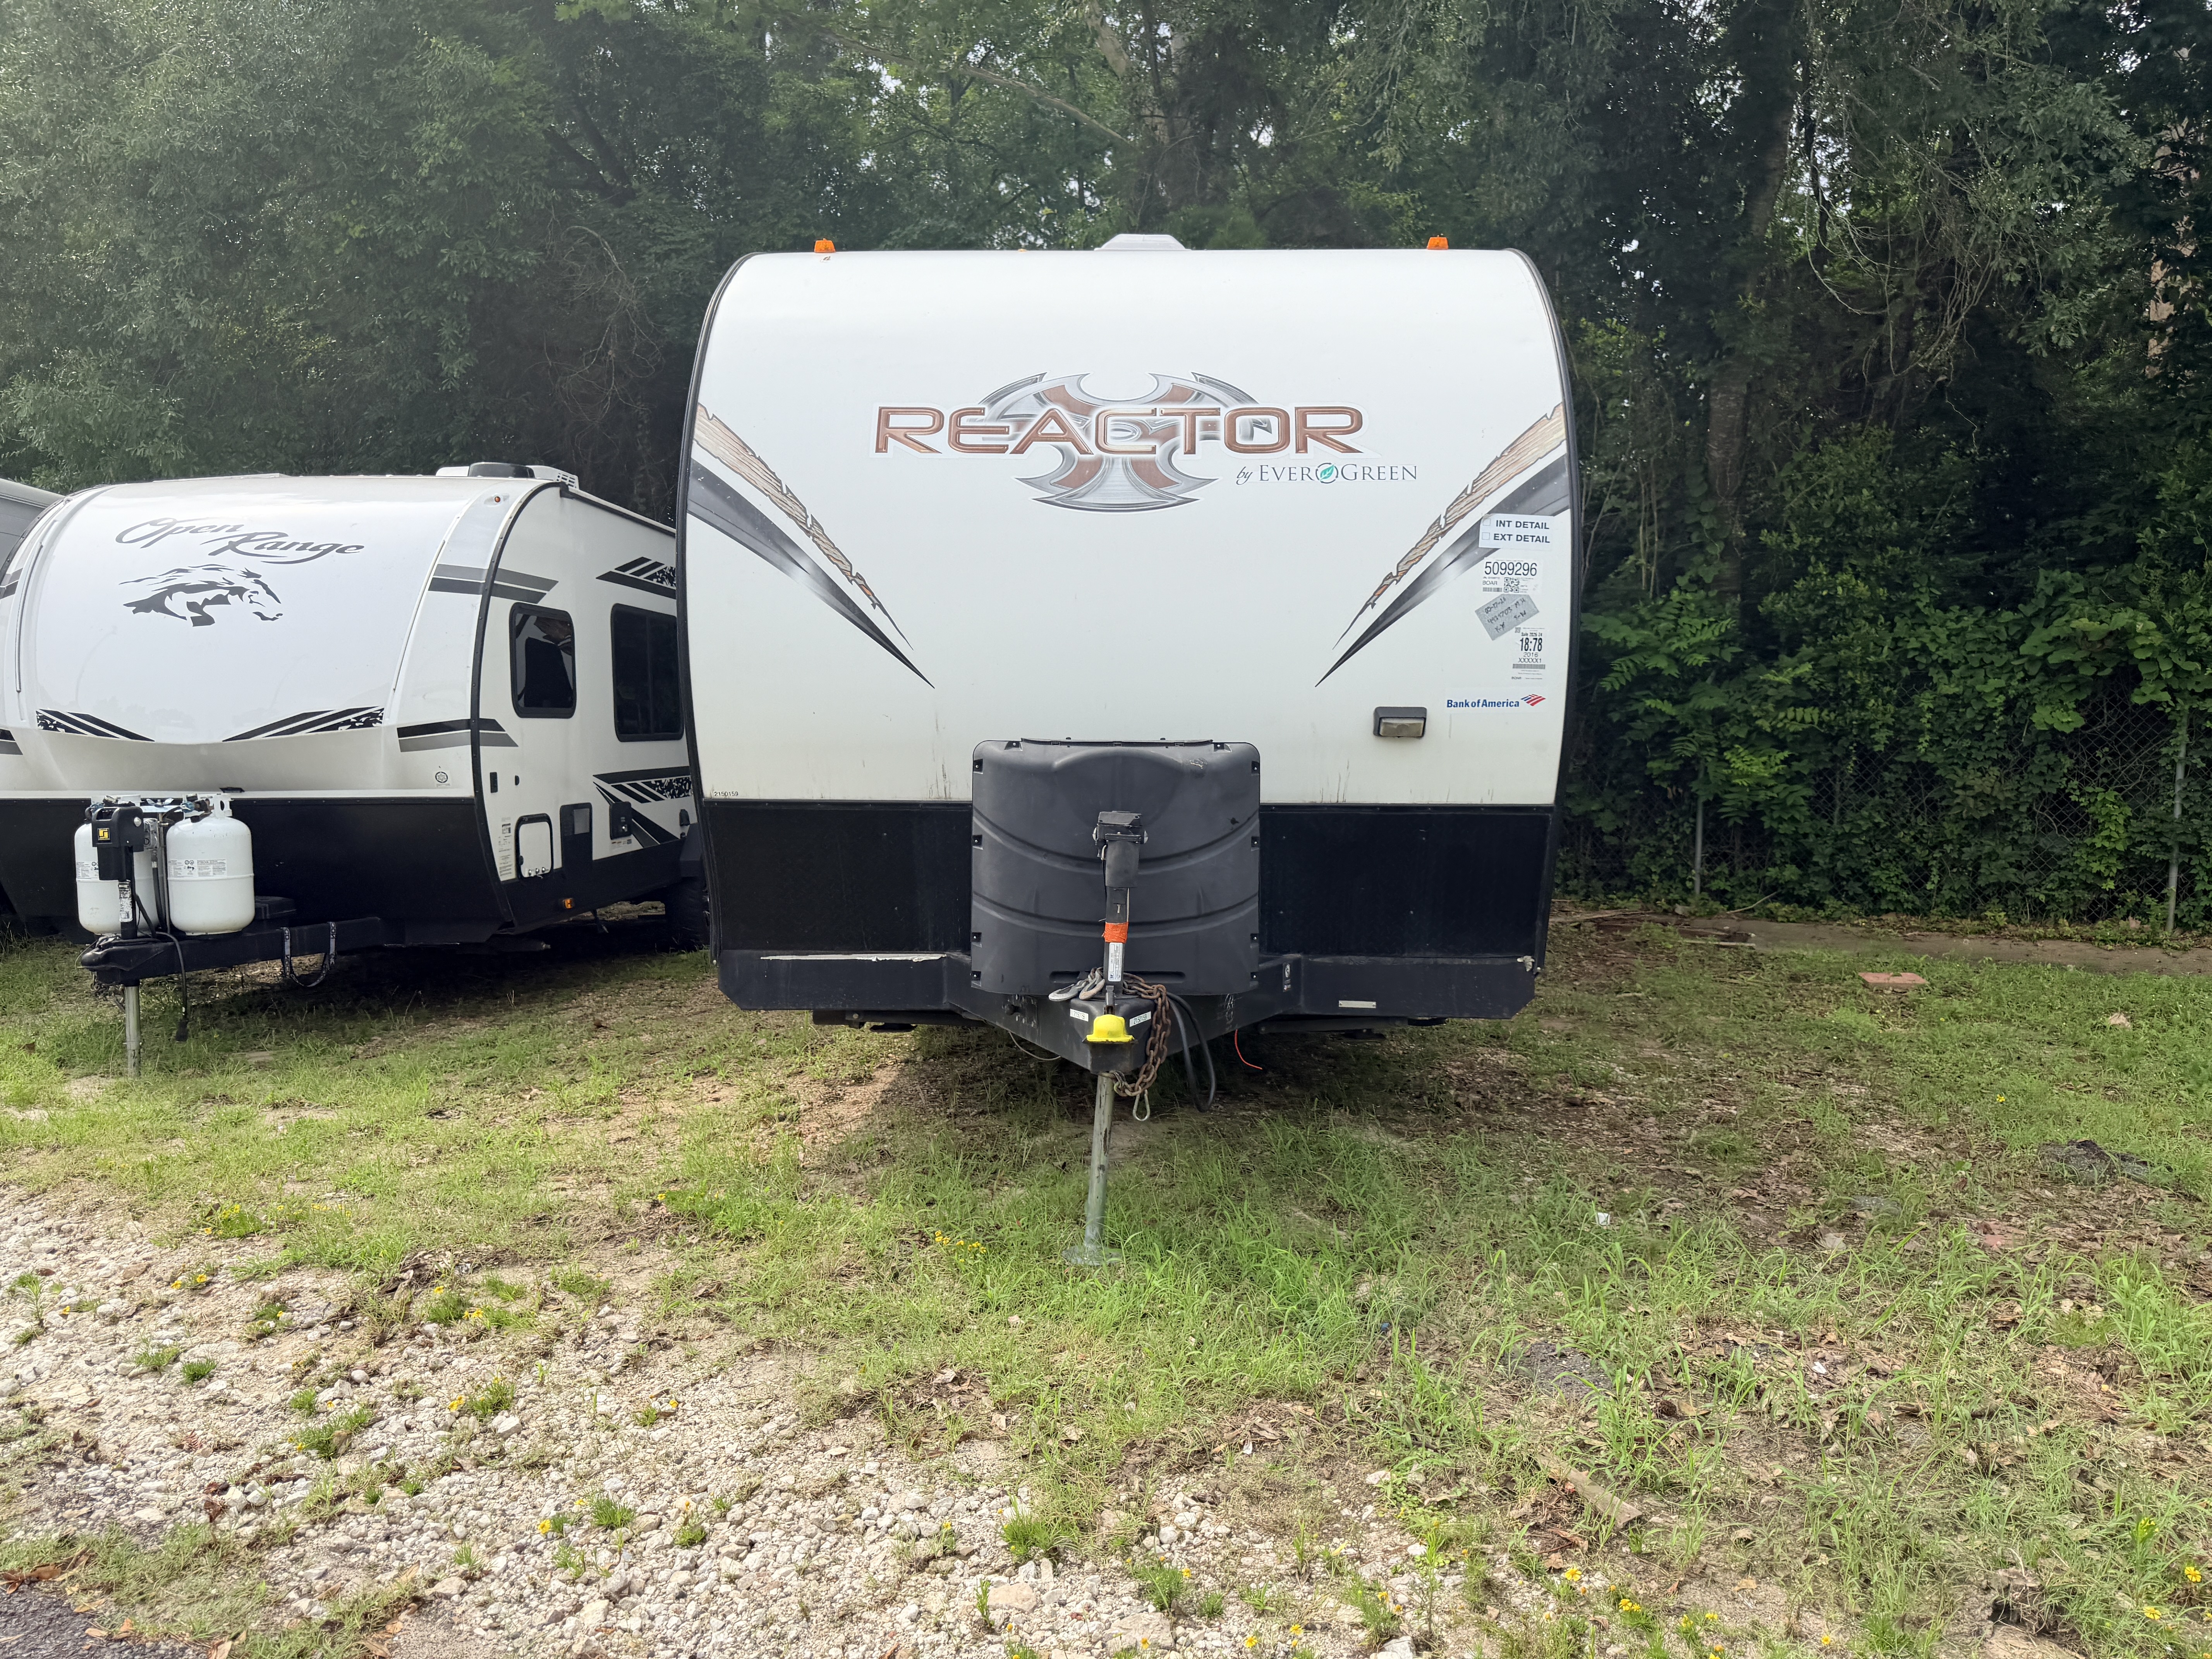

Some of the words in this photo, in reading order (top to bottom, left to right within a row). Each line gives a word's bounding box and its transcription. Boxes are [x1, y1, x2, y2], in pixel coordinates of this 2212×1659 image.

[875, 406, 1364, 455] REACTOR
[1236, 466, 1252, 485] by
[1515, 521, 1550, 529] DETAIL
[115, 517, 244, 549] Open
[1493, 533, 1513, 541] EXT
[1516, 534, 1550, 543] DETAIL
[200, 531, 365, 565] Range
[1484, 562, 1537, 576] 5099296
[1520, 637, 1542, 652] 18:78
[1447, 699, 1470, 708] Bank
[1471, 699, 1480, 708] of
[1481, 699, 1520, 708] America
